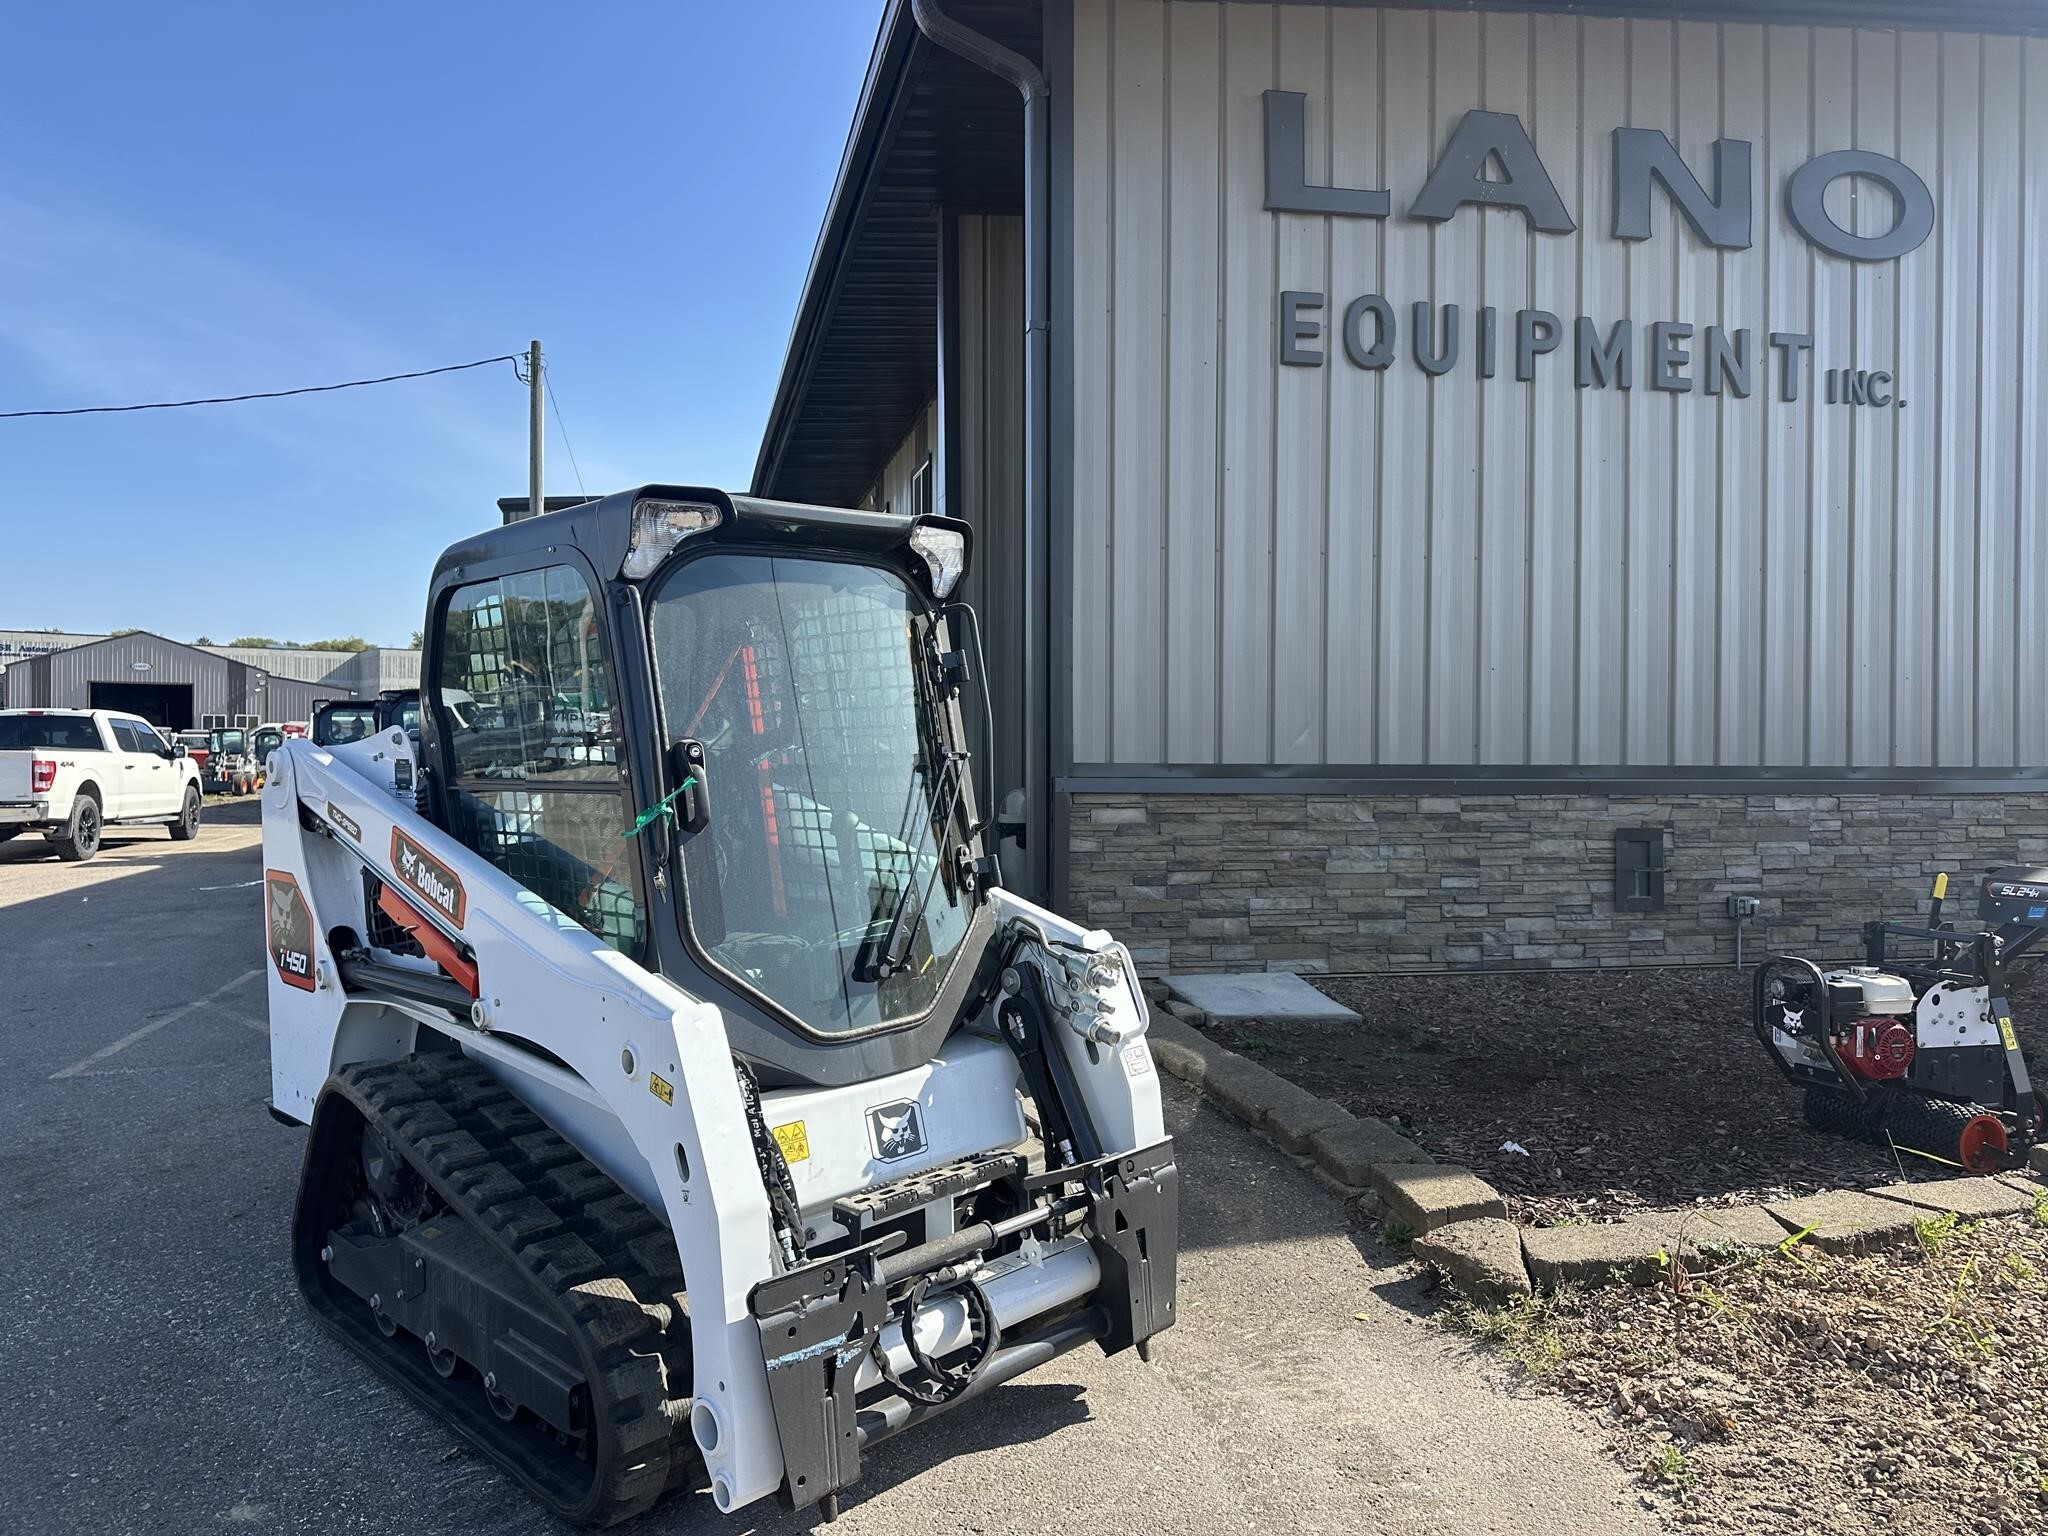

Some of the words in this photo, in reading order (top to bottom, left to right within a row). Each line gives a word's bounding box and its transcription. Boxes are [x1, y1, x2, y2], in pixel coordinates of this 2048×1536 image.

[1263, 89, 1935, 262] LANO
[1280, 291, 1814, 404] EQUIPMENT
[1825, 369, 1907, 409] INC.
[417, 861, 455, 914] Bobcat
[280, 948, 307, 975] T450
